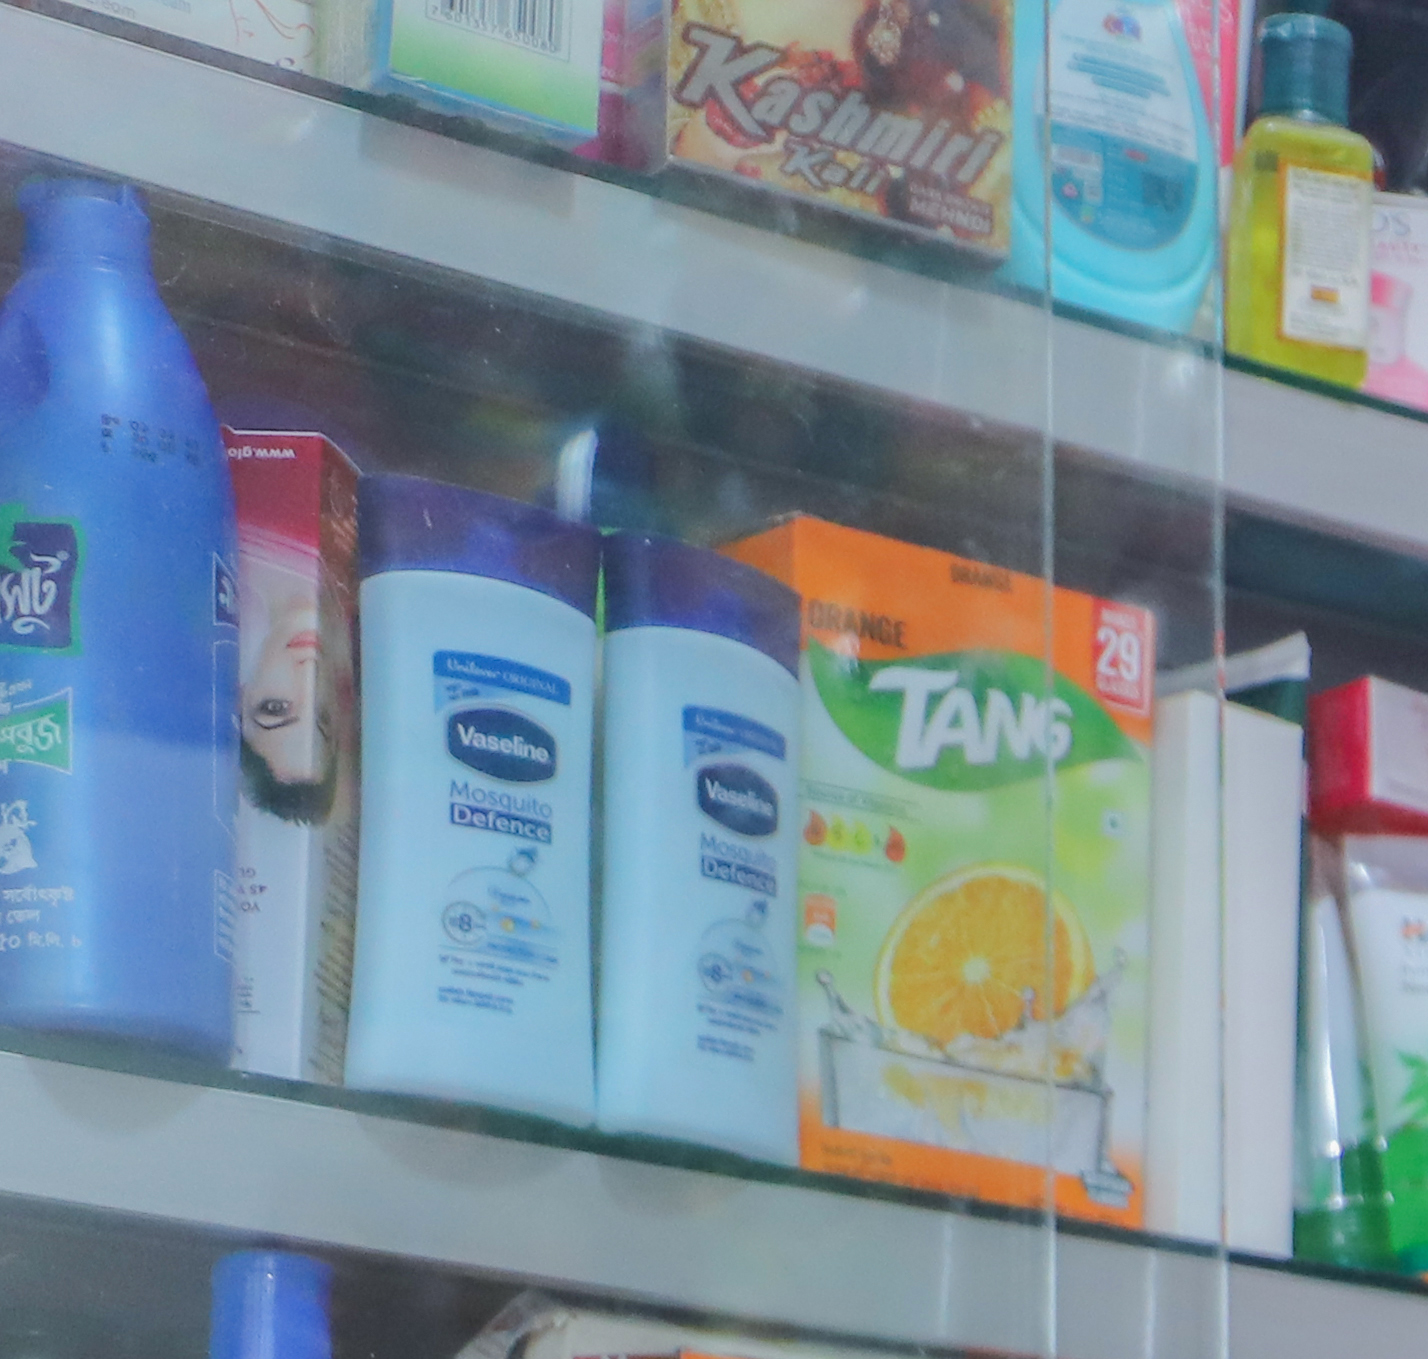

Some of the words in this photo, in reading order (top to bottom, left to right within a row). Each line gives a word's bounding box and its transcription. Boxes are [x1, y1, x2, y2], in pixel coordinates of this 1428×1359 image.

[673, 22, 1003, 184] Kashmiri
[780, 138, 886, 195] Kali
[807, 599, 907, 651] ORANGE
[1096, 629, 1141, 683] 29
[502, 672, 560, 695] ORIGINAL
[457, 722, 550, 763] Vaseline
[868, 664, 1075, 772] TANG
[450, 778, 551, 819] Mosquito
[453, 803, 549, 841] Defence
